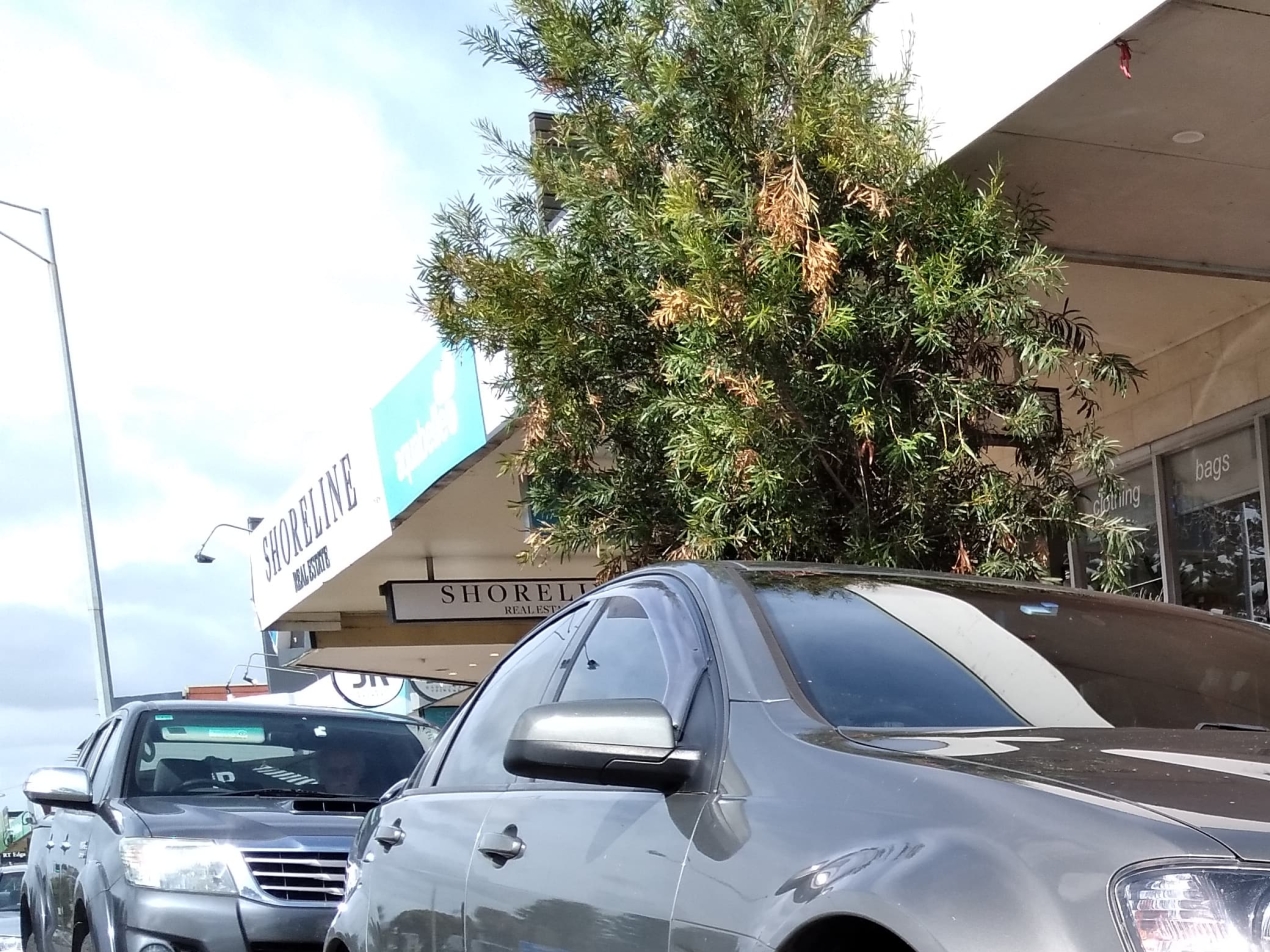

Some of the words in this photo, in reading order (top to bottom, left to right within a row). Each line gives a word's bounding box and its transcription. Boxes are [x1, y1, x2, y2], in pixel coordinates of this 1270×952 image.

[1194, 450, 1231, 483] bags
[262, 452, 358, 583] SHORELINE
[504, 605, 536, 615] REAL
[537, 604, 567, 615] EST
